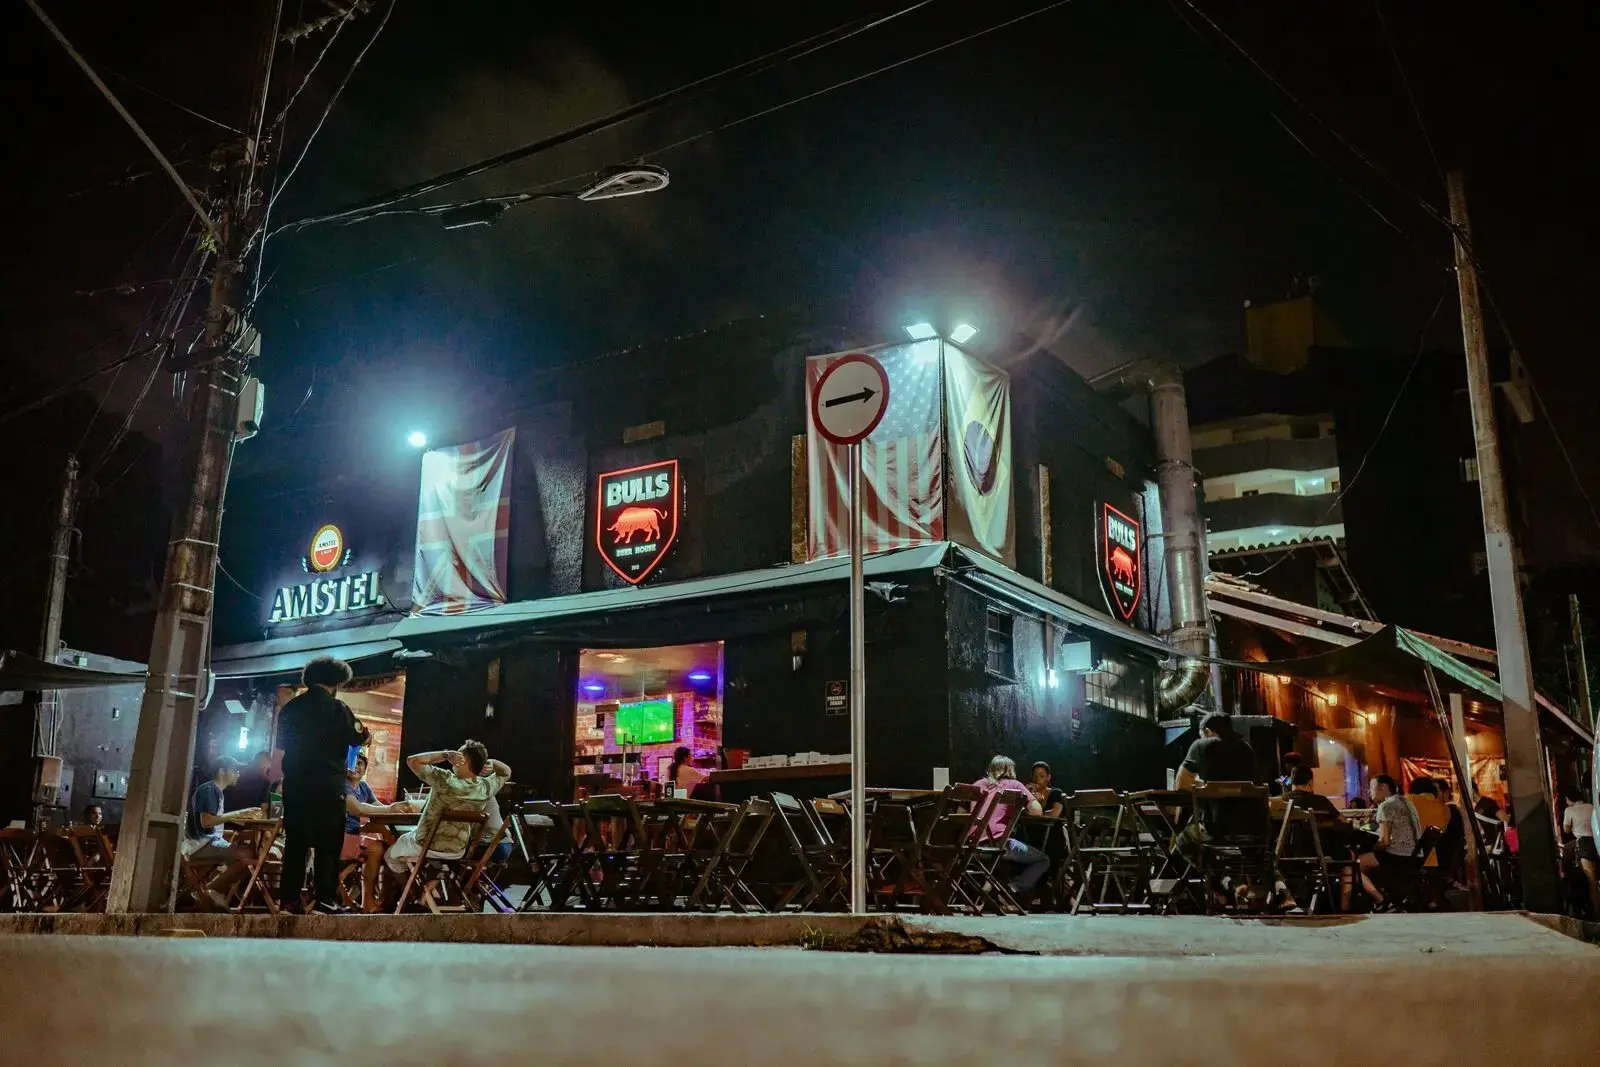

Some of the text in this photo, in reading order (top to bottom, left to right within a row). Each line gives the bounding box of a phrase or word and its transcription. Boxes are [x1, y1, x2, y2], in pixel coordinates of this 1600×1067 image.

[607, 473, 670, 507] BULLS
[616, 543, 657, 557] BEER HOUSE
[1108, 515, 1136, 552] BULLS
[267, 572, 385, 623] AMSTEL
